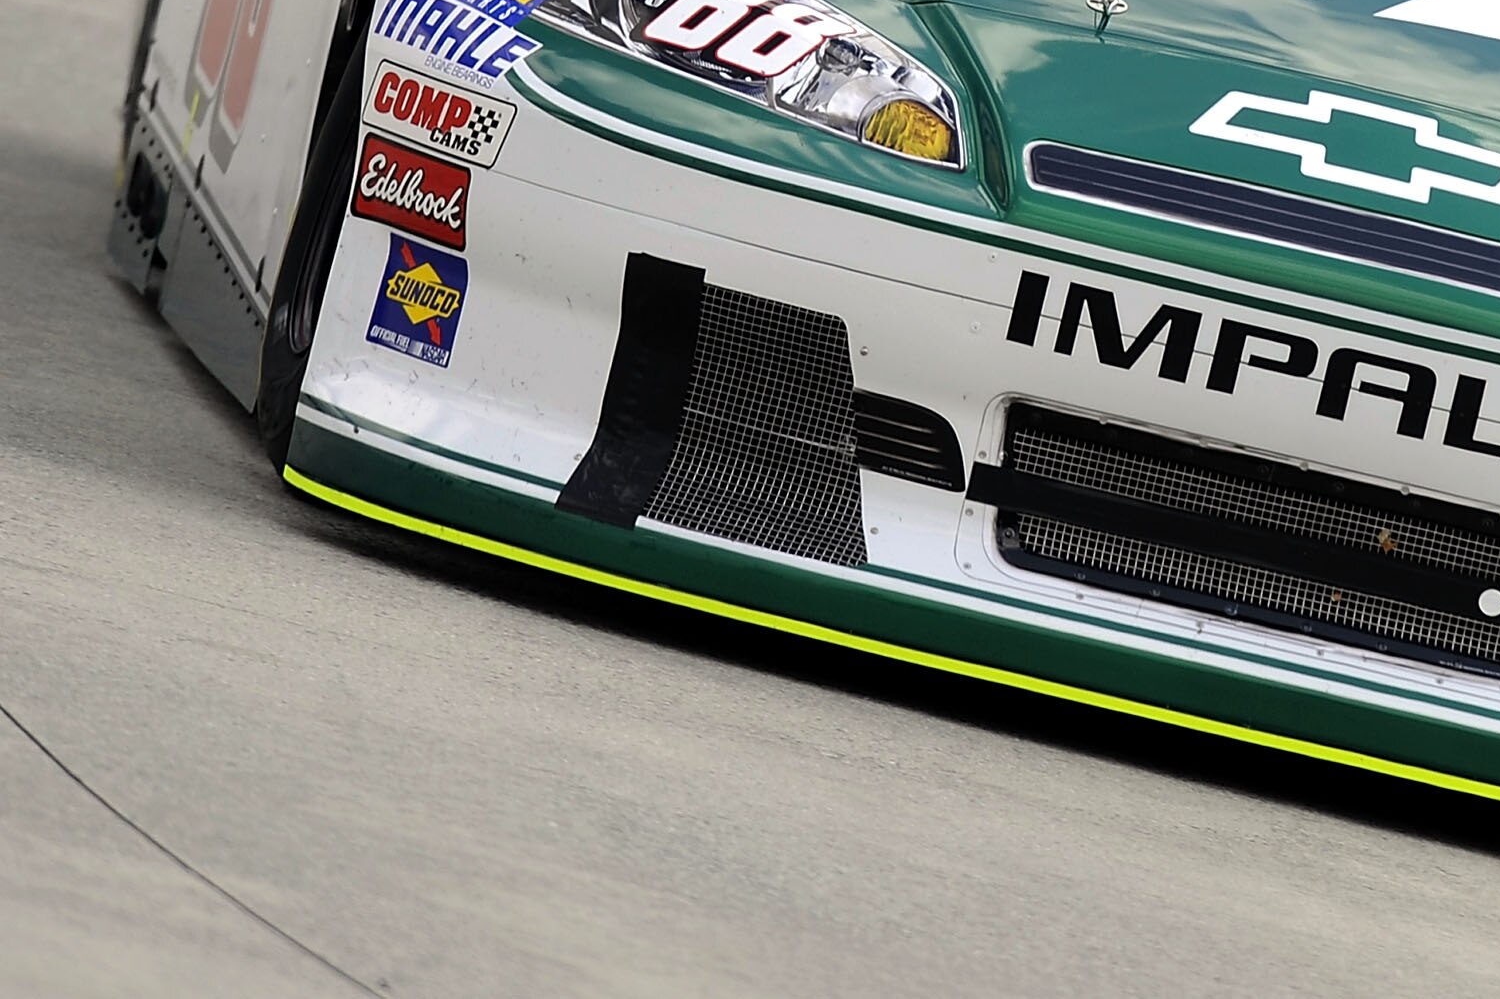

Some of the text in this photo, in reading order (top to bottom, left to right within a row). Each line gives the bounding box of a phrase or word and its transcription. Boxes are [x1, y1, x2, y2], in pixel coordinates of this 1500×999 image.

[424, 55, 495, 90] ENGINE BEARINGS
[373, 72, 473, 134] COMP
[429, 127, 482, 156] CAMS
[360, 153, 463, 230] Edelbrock
[388, 274, 459, 316] SUNOCO
